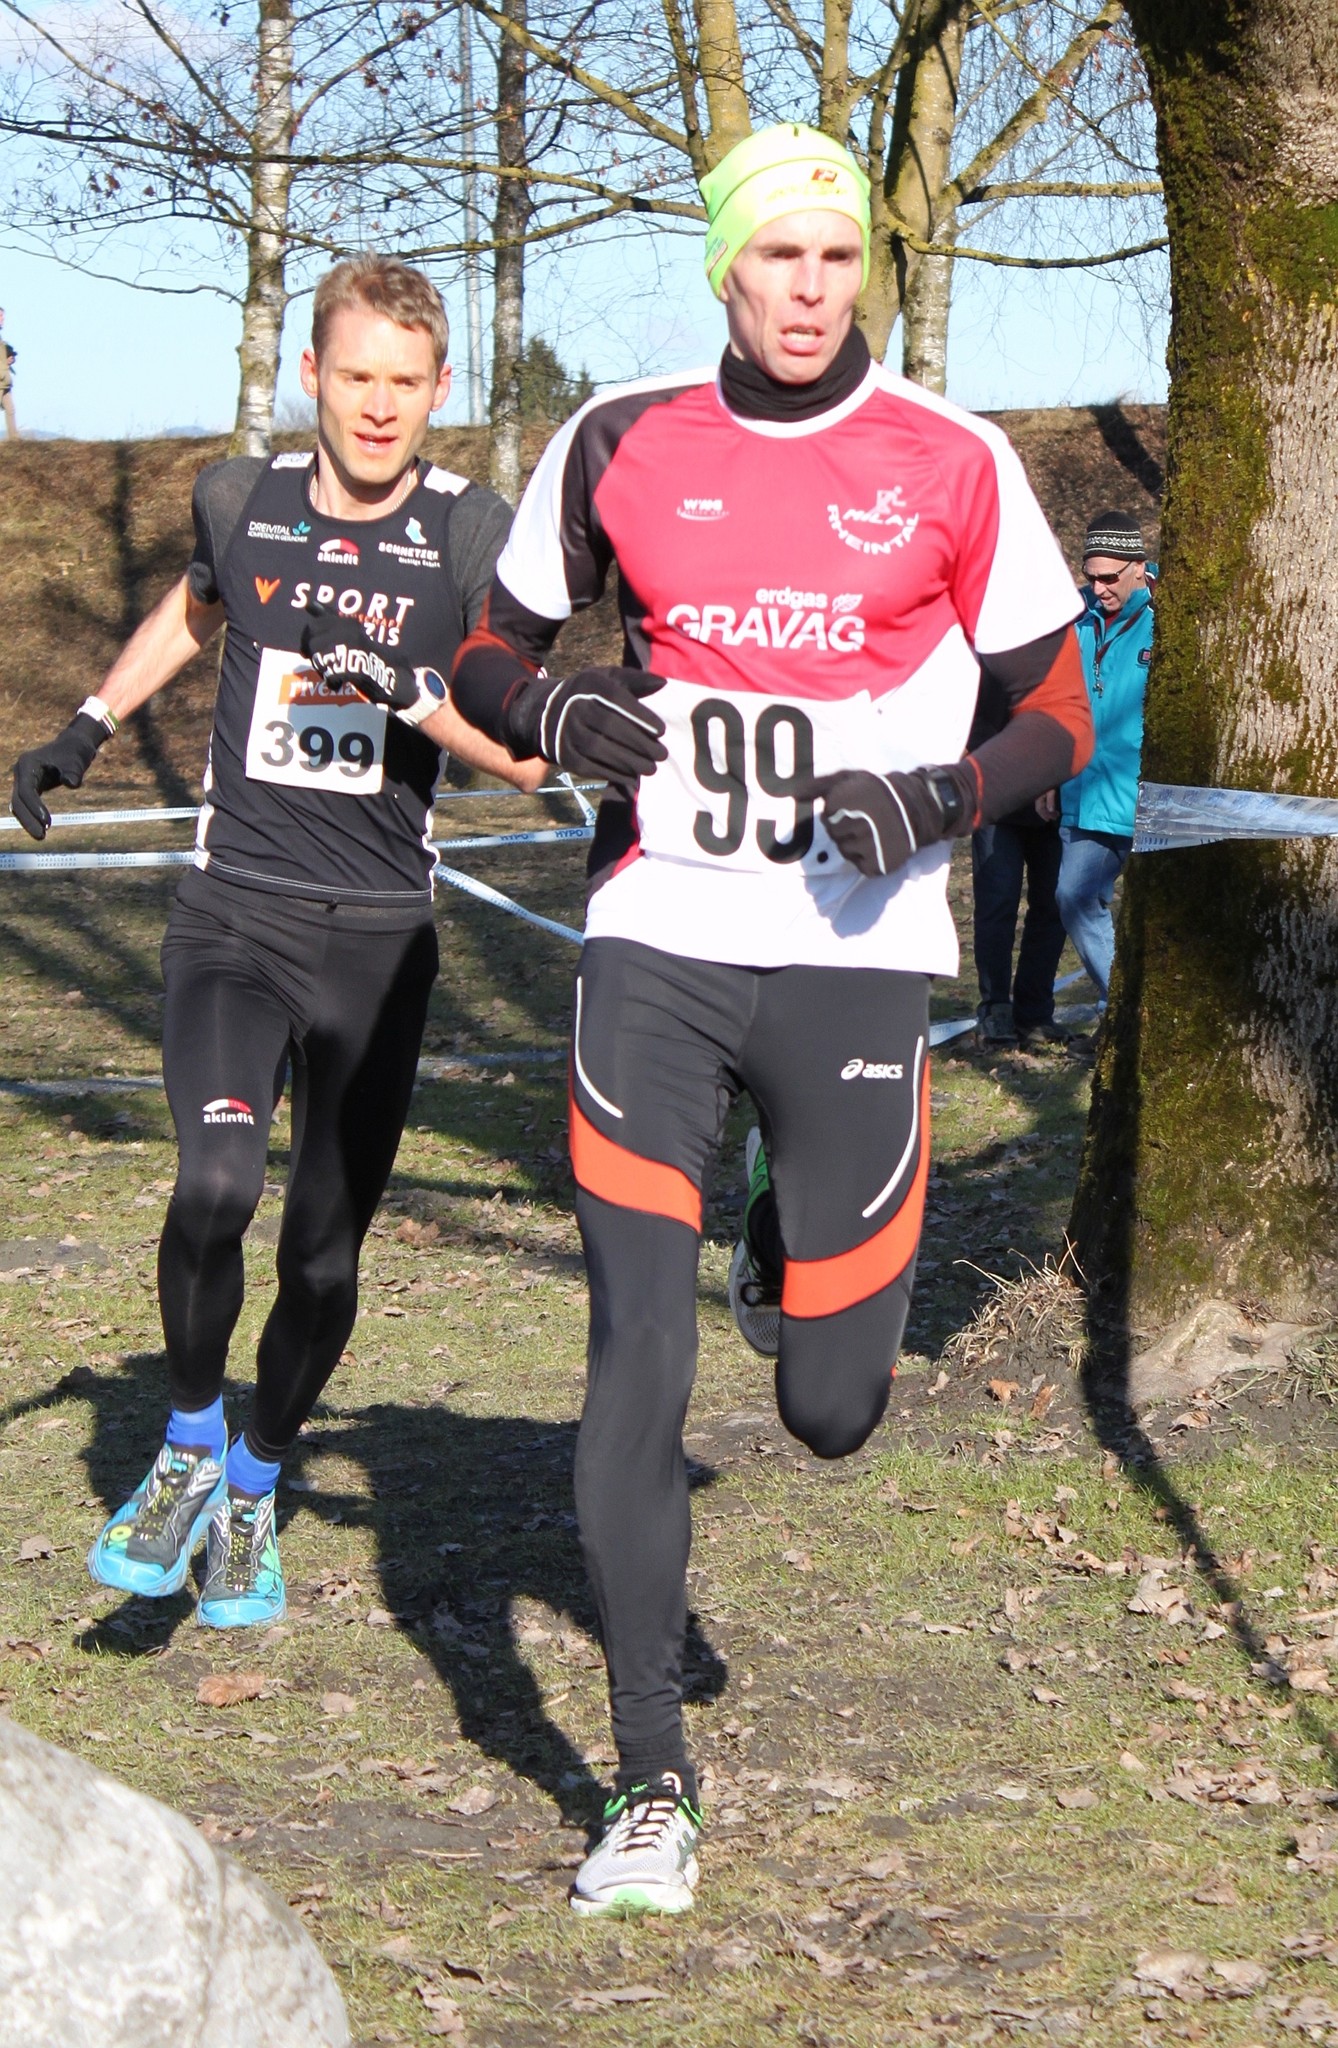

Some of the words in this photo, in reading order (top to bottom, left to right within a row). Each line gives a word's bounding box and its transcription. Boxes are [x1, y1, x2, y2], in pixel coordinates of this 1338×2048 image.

[827, 504, 919, 555] RHEINTAL
[317, 552, 360, 565] skinfit
[292, 583, 415, 625] SPORT
[756, 586, 828, 609] erdgas
[666, 603, 866, 652] GRAVAG
[260, 720, 376, 778] 399
[690, 697, 815, 864] 99
[555, 829, 583, 838] HYPO
[862, 1063, 904, 1079] asics
[203, 1112, 254, 1125] skinfit
